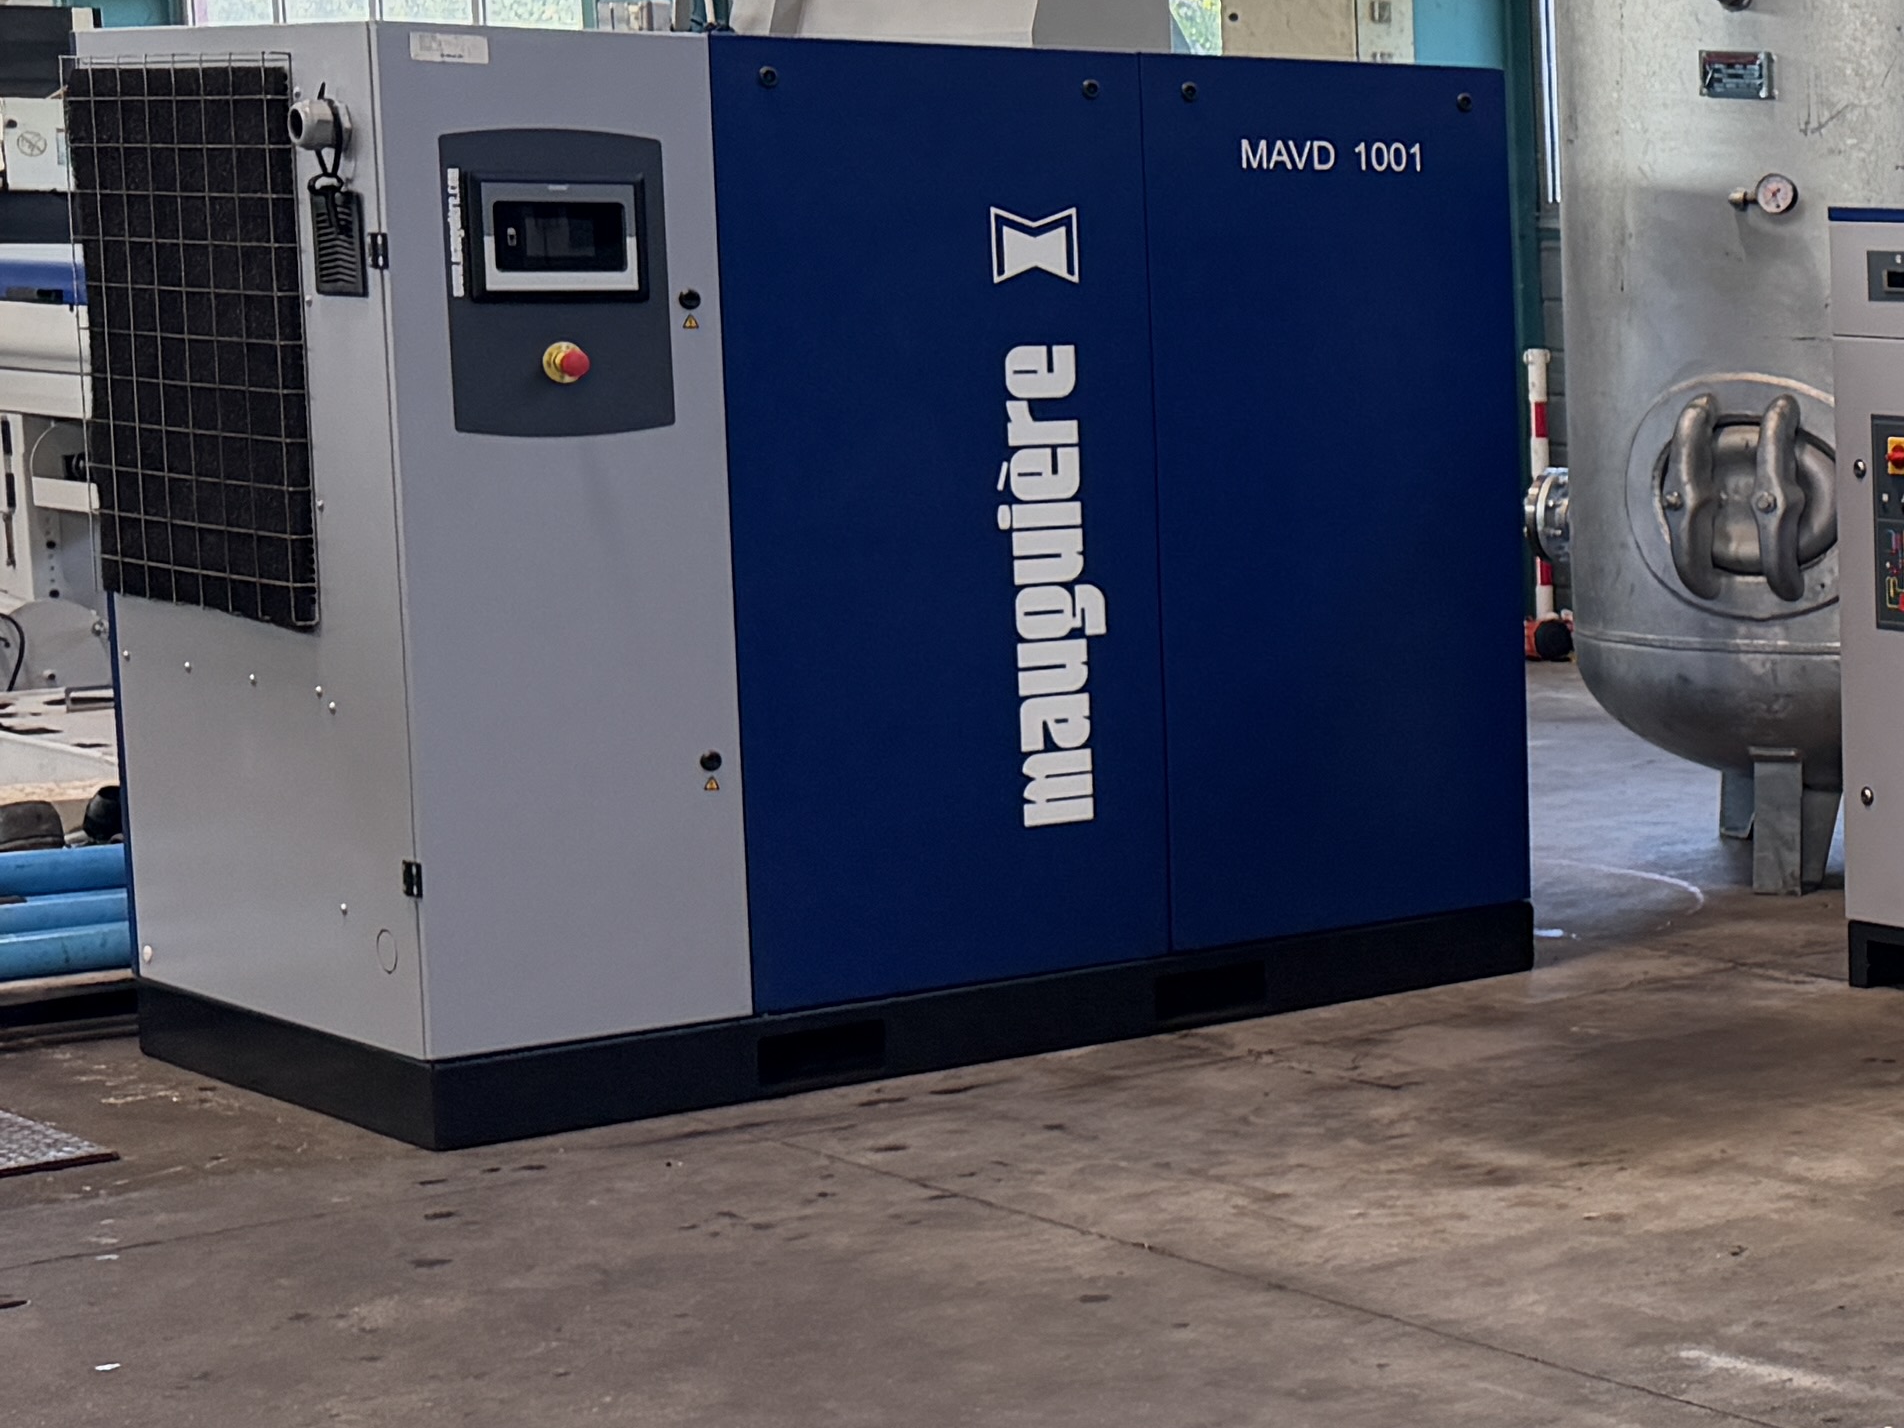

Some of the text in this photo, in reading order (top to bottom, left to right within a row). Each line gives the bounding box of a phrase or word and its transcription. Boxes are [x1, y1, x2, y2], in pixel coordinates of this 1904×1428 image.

[1241, 138, 1422, 172] MAVD 1001
[996, 344, 1107, 827] mauguière
